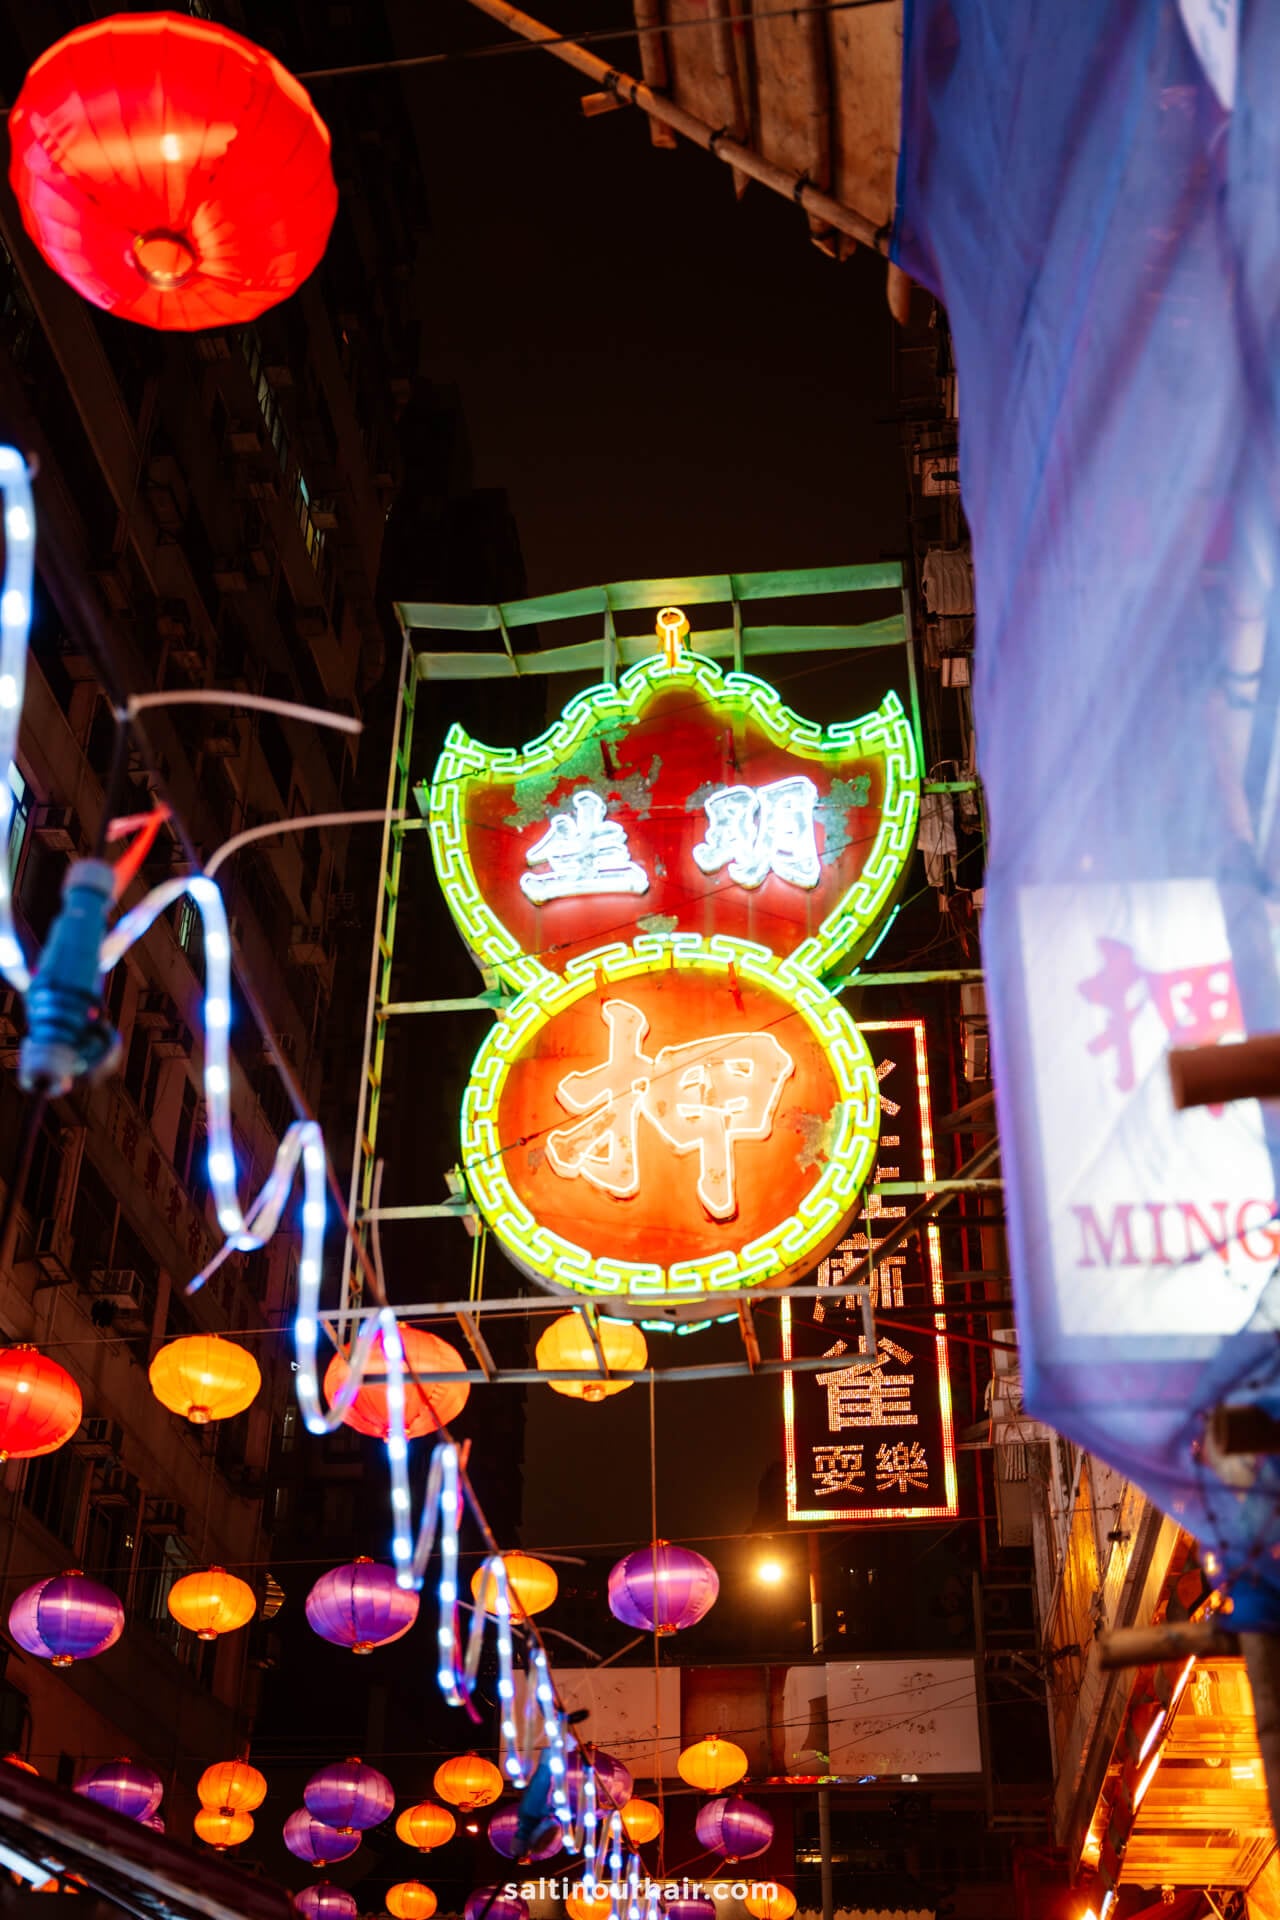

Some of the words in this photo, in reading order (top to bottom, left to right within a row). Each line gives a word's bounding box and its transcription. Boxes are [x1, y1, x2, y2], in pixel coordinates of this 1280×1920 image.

[545, 999, 796, 1223] 押
[1071, 1199, 1280, 1268] MING
[811, 1441, 930, 1497] 耍樂
